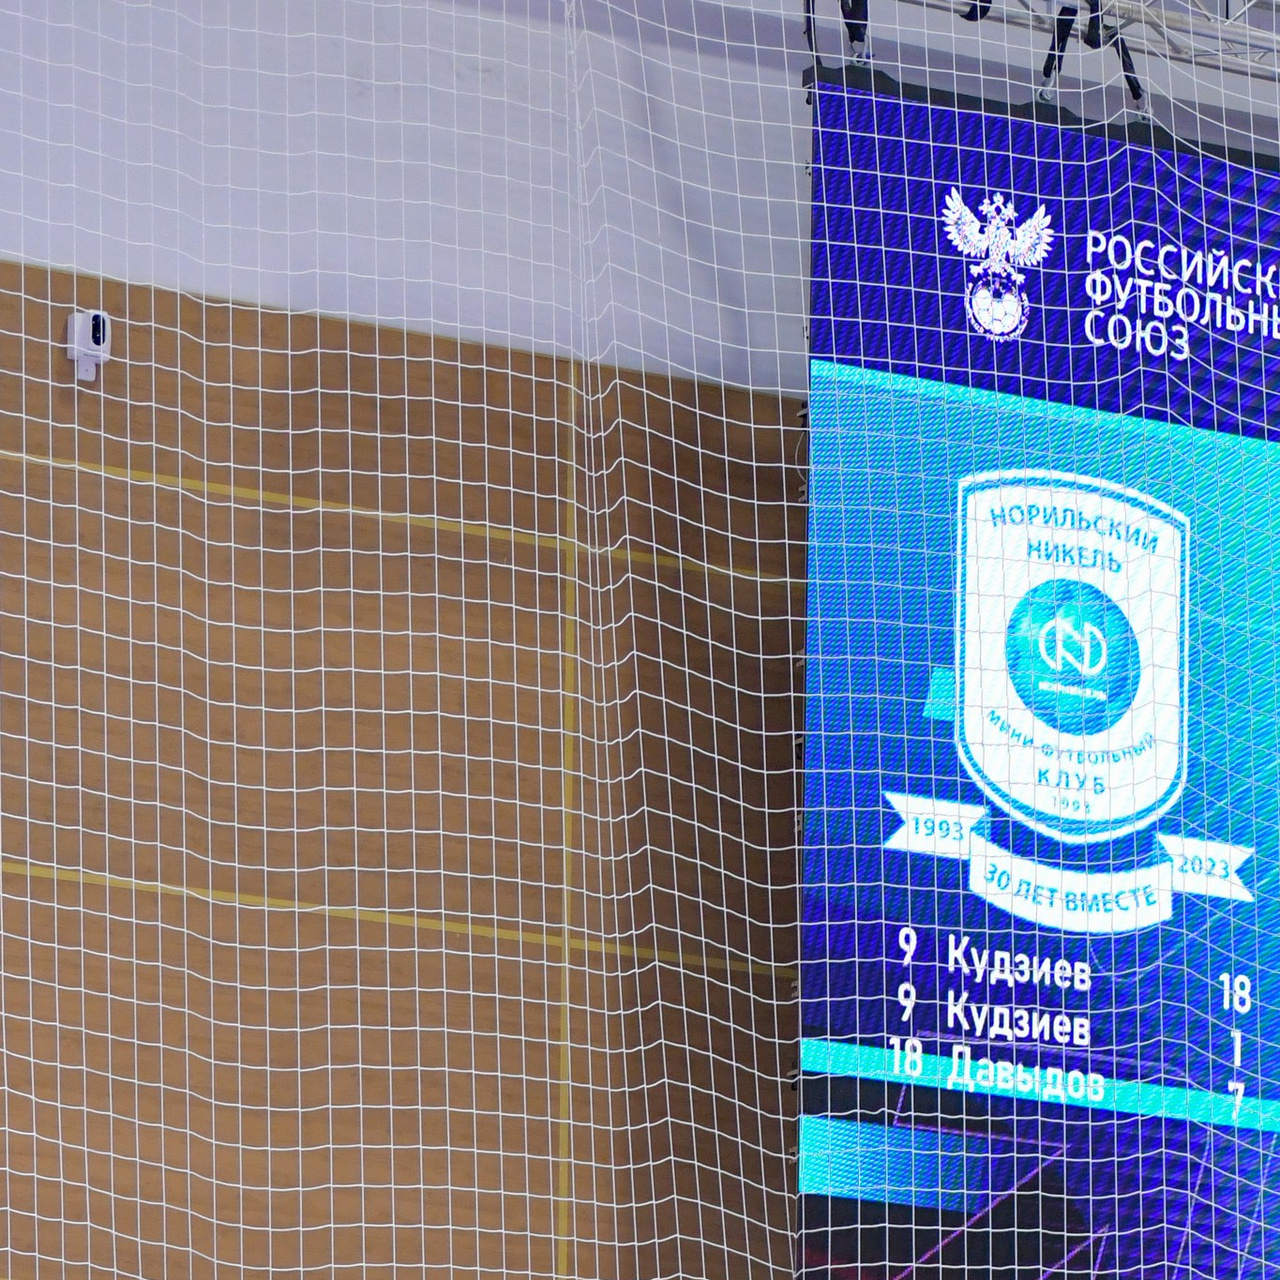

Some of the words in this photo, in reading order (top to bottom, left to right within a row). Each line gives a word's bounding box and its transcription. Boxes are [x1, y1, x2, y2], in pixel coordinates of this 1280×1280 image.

[1084, 309, 1190, 360] СОЮЗ
[990, 507, 1160, 555] НОРИЛЬСКИЙ
[1027, 538, 1123, 574] НИКЕЛЬ
[1037, 768, 1106, 795] КЛУБ
[911, 816, 965, 842] 1993
[982, 863, 1011, 892] 30
[1017, 878, 1059, 910] ЛЕТ
[1065, 884, 1158, 913] ВМЕСТЕ
[1178, 856, 1231, 880] 2023
[898, 927, 917, 967] 9
[948, 933, 1092, 992] Кудзиев
[1218, 972, 1252, 1015] 18
[897, 982, 916, 1023] 9
[947, 989, 1091, 1046] Кудзиев
[1230, 1029, 1242, 1067] 1
[888, 1036, 923, 1078] 18
[946, 1044, 1106, 1103] Давыдов
[1227, 1081, 1245, 1119] 7
